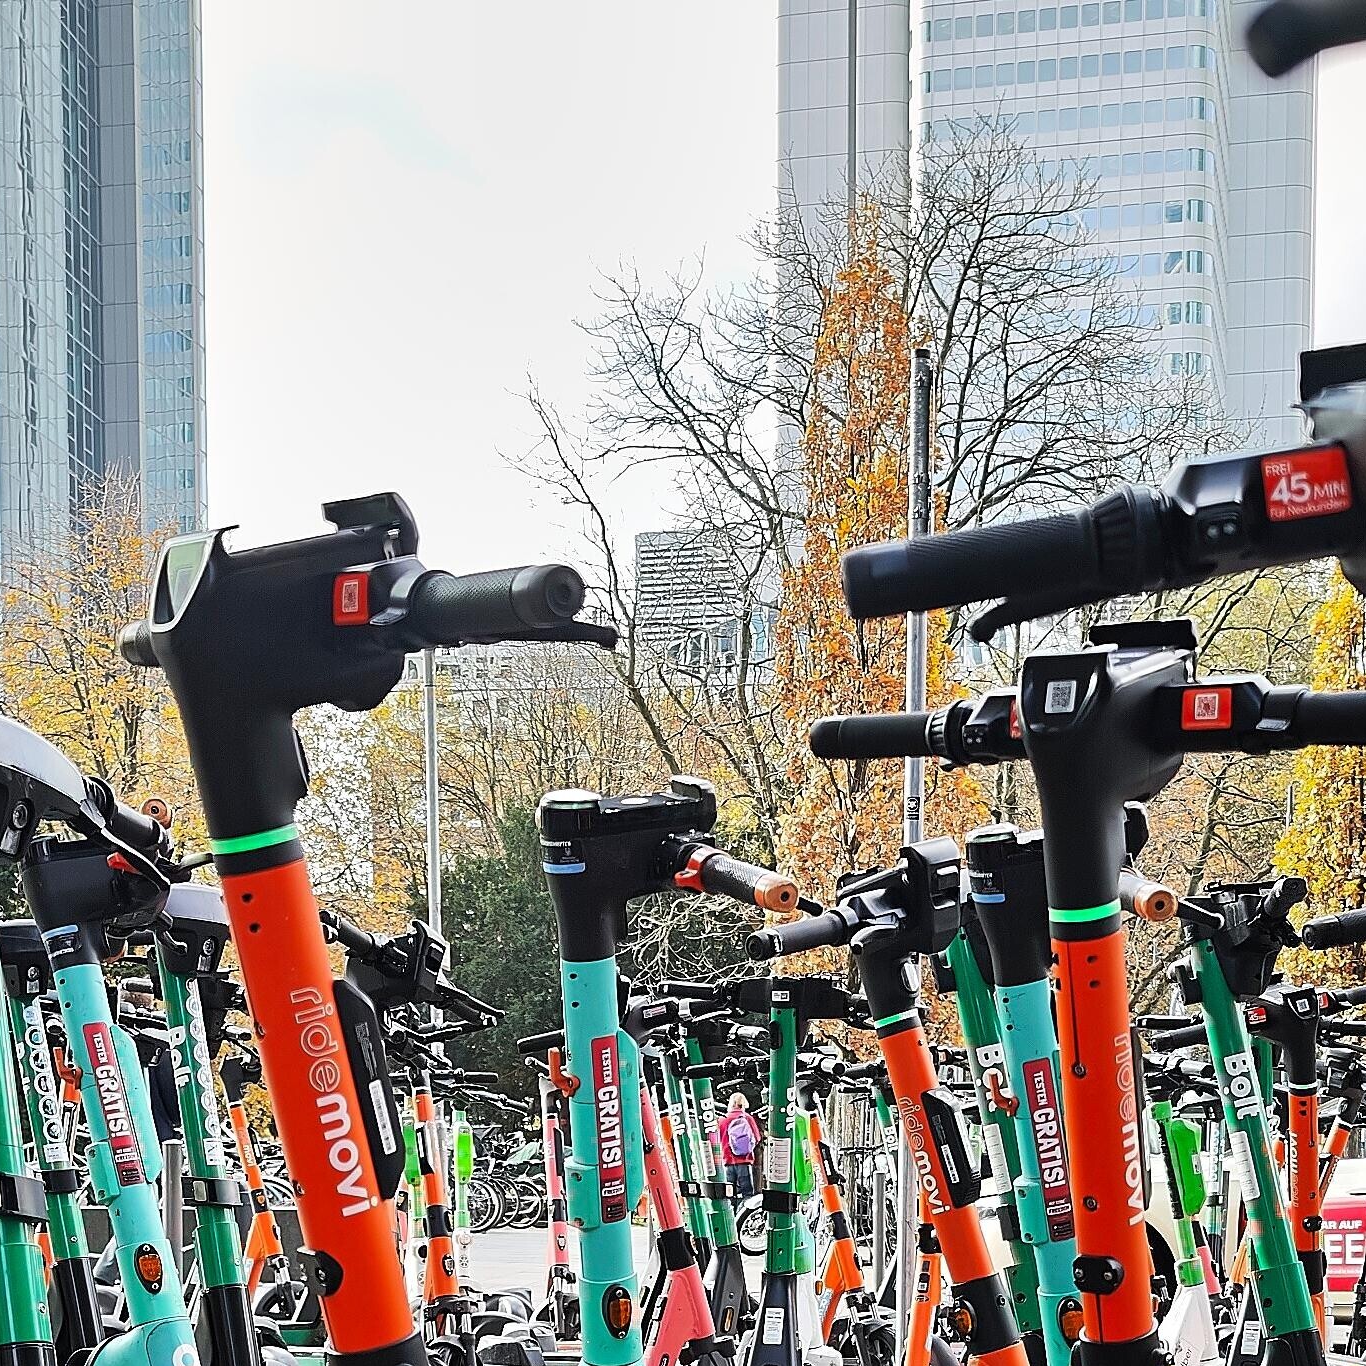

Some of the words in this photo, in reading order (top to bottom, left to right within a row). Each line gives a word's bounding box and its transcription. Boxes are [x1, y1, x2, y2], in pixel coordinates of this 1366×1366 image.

[1265, 462, 1292, 478] FREI
[1270, 472, 1312, 505] 45
[1313, 481, 1348, 501] MIN
[91, 1032, 109, 1065] TESTEN
[601, 1047, 613, 1084] TESTEN
[96, 1064, 131, 1139] GRATIS!
[290, 986, 380, 1218] ridemovi
[1033, 1070, 1049, 1106] TESTEN
[1223, 1051, 1261, 1120] Bolt
[597, 1085, 622, 1169] GRATIS!
[1033, 1107, 1067, 1189] GRATIS!
[898, 1096, 951, 1216] ridemovi
[1342, 1219, 1363, 1231] AUF
